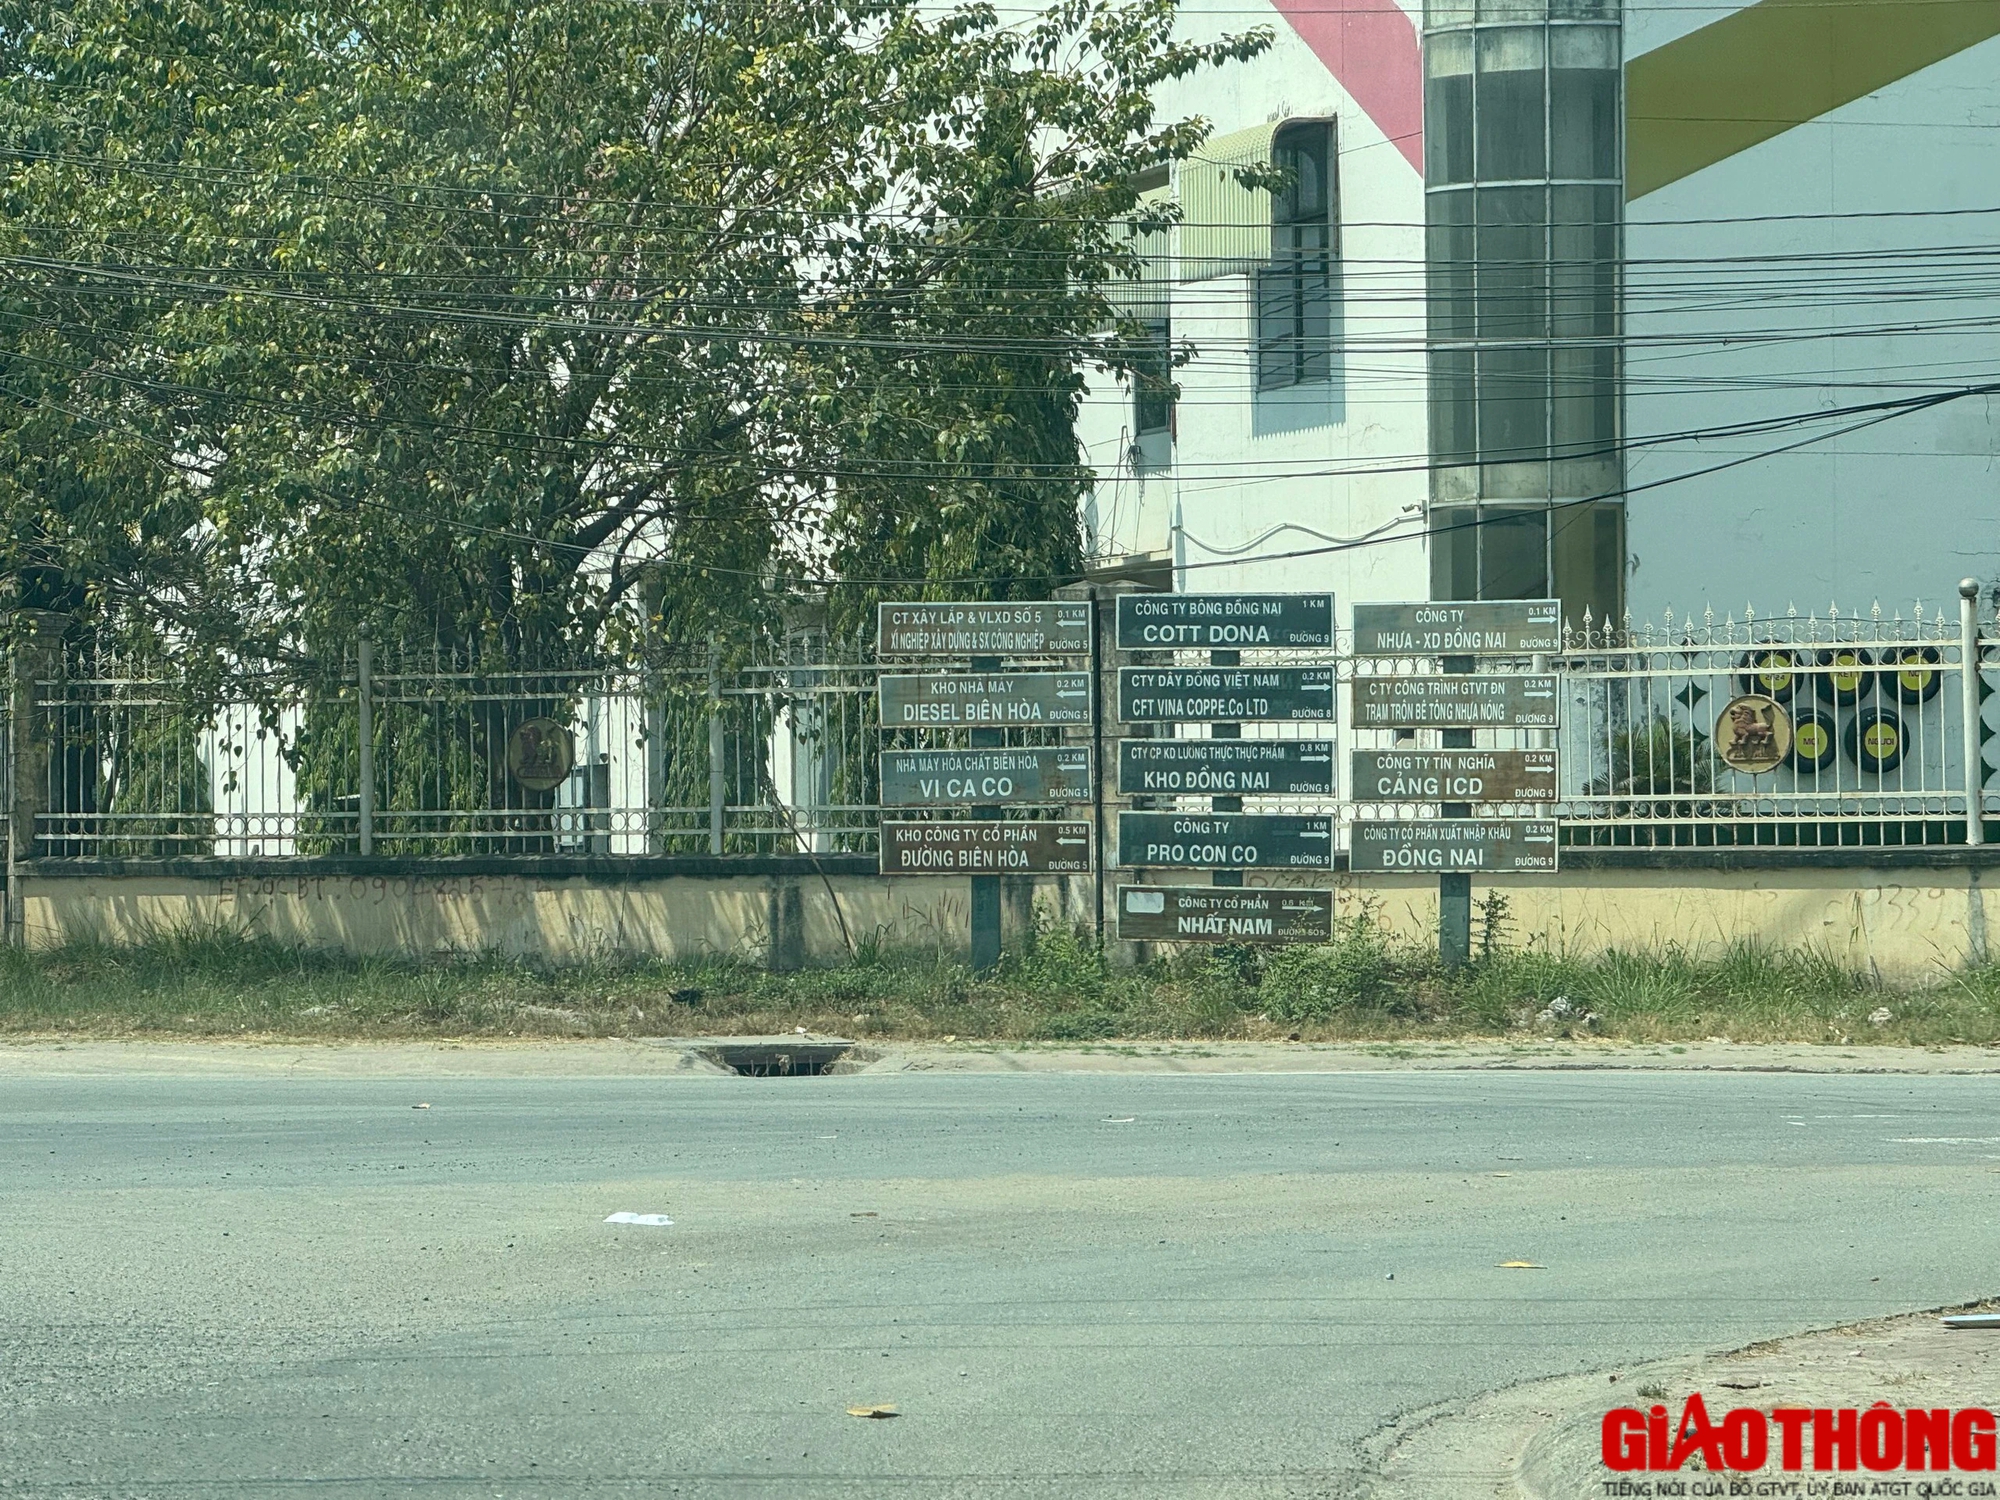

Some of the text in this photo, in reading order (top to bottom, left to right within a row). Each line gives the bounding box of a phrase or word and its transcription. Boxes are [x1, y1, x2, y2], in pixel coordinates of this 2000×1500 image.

[893, 606, 1041, 625] CT XÂY LẮP & VLXD SỐ 5
[1136, 600, 1168, 615] CÔNG
[1172, 603, 1185, 614] TY
[1189, 599, 1222, 614] BÔNG
[1263, 603, 1281, 614] NAI
[1416, 607, 1464, 623] CÔNG TY
[1543, 607, 1556, 615] KM
[901, 629, 929, 651] NGHIỆP
[931, 628, 946, 649] XÂY
[949, 631, 970, 651] DỰNG
[972, 633, 977, 649] &
[979, 632, 989, 649] SX
[991, 629, 1013, 649] CÔNG
[1015, 629, 1044, 651] NGHIỆP
[1143, 625, 1269, 642] COTT DONA
[1289, 631, 1329, 643] ĐƯỜNG 9
[1378, 631, 1412, 651] NHỰA
[1423, 633, 1440, 648] XD
[1444, 626, 1480, 648] ĐỒNG
[1485, 632, 1506, 648] NAI
[1050, 638, 1088, 649] ĐƯỜNG 5
[1132, 670, 1279, 690] CTY DÂY ĐỒNG VIỆT NAM
[1302, 672, 1330, 680] 0.2 KM
[1524, 680, 1536, 688] 0.2
[931, 677, 1014, 694] KHO NHÀ MÁY
[1395, 680, 1424, 695] CÔNG
[1427, 679, 1458, 695] TRÌNH
[1461, 682, 1488, 694] GTVT
[1491, 683, 1505, 694] ĐN
[904, 698, 1041, 721] DIESEL BIÊN HÒA
[1133, 699, 1154, 716] CFT
[1157, 699, 1183, 716] VINA
[1246, 699, 1267, 715] LTD
[1366, 699, 1504, 722] TRẠM TRỘN BÊ TÔNG NHỰA NÓNG
[1131, 747, 1147, 759] CTY
[1150, 747, 1161, 759] CP
[1164, 747, 1175, 759] KD
[1209, 745, 1232, 762] THỰC
[1235, 745, 1257, 762] THỰC
[1300, 744, 1328, 752] 0.8 KM
[896, 751, 1038, 773] NHÀ MÁY HÓA CHẤT BIÊN HÒA
[1058, 754, 1085, 762] 0.2 KM
[1377, 754, 1495, 770] CÔNG TY TÍN NGHĨA
[1144, 765, 1269, 789] KHO ĐỒNG NAI
[1378, 772, 1483, 795] CẢNG ICD
[920, 777, 1012, 798] VI CA CO
[1050, 785, 1088, 797] ĐƯỜNG 5
[896, 823, 1037, 842] KHO CÔNG TY CỔ PHẦN
[1174, 818, 1229, 833] CÔNG TY
[1364, 824, 1387, 840] CÔNG
[1389, 828, 1399, 840] TY
[1402, 822, 1413, 840] CỔ
[1440, 823, 1461, 840] XUẤT
[1463, 824, 1485, 841] NHẬP
[1540, 825, 1552, 833] KM
[902, 844, 1028, 867] ĐƯỜNG BIÊN HÒA
[1147, 844, 1184, 861] PRO
[1189, 845, 1226, 862] CON
[1232, 845, 1257, 862] CO
[1383, 842, 1483, 866] ĐỒNG NAI
[1049, 858, 1087, 870] ĐƯỜNG 5
[1179, 895, 1206, 908] CÔNG
[1209, 899, 1223, 908] TY
[1224, 895, 1239, 909] CỔ
[1178, 911, 1272, 935] NHẤT NAM
